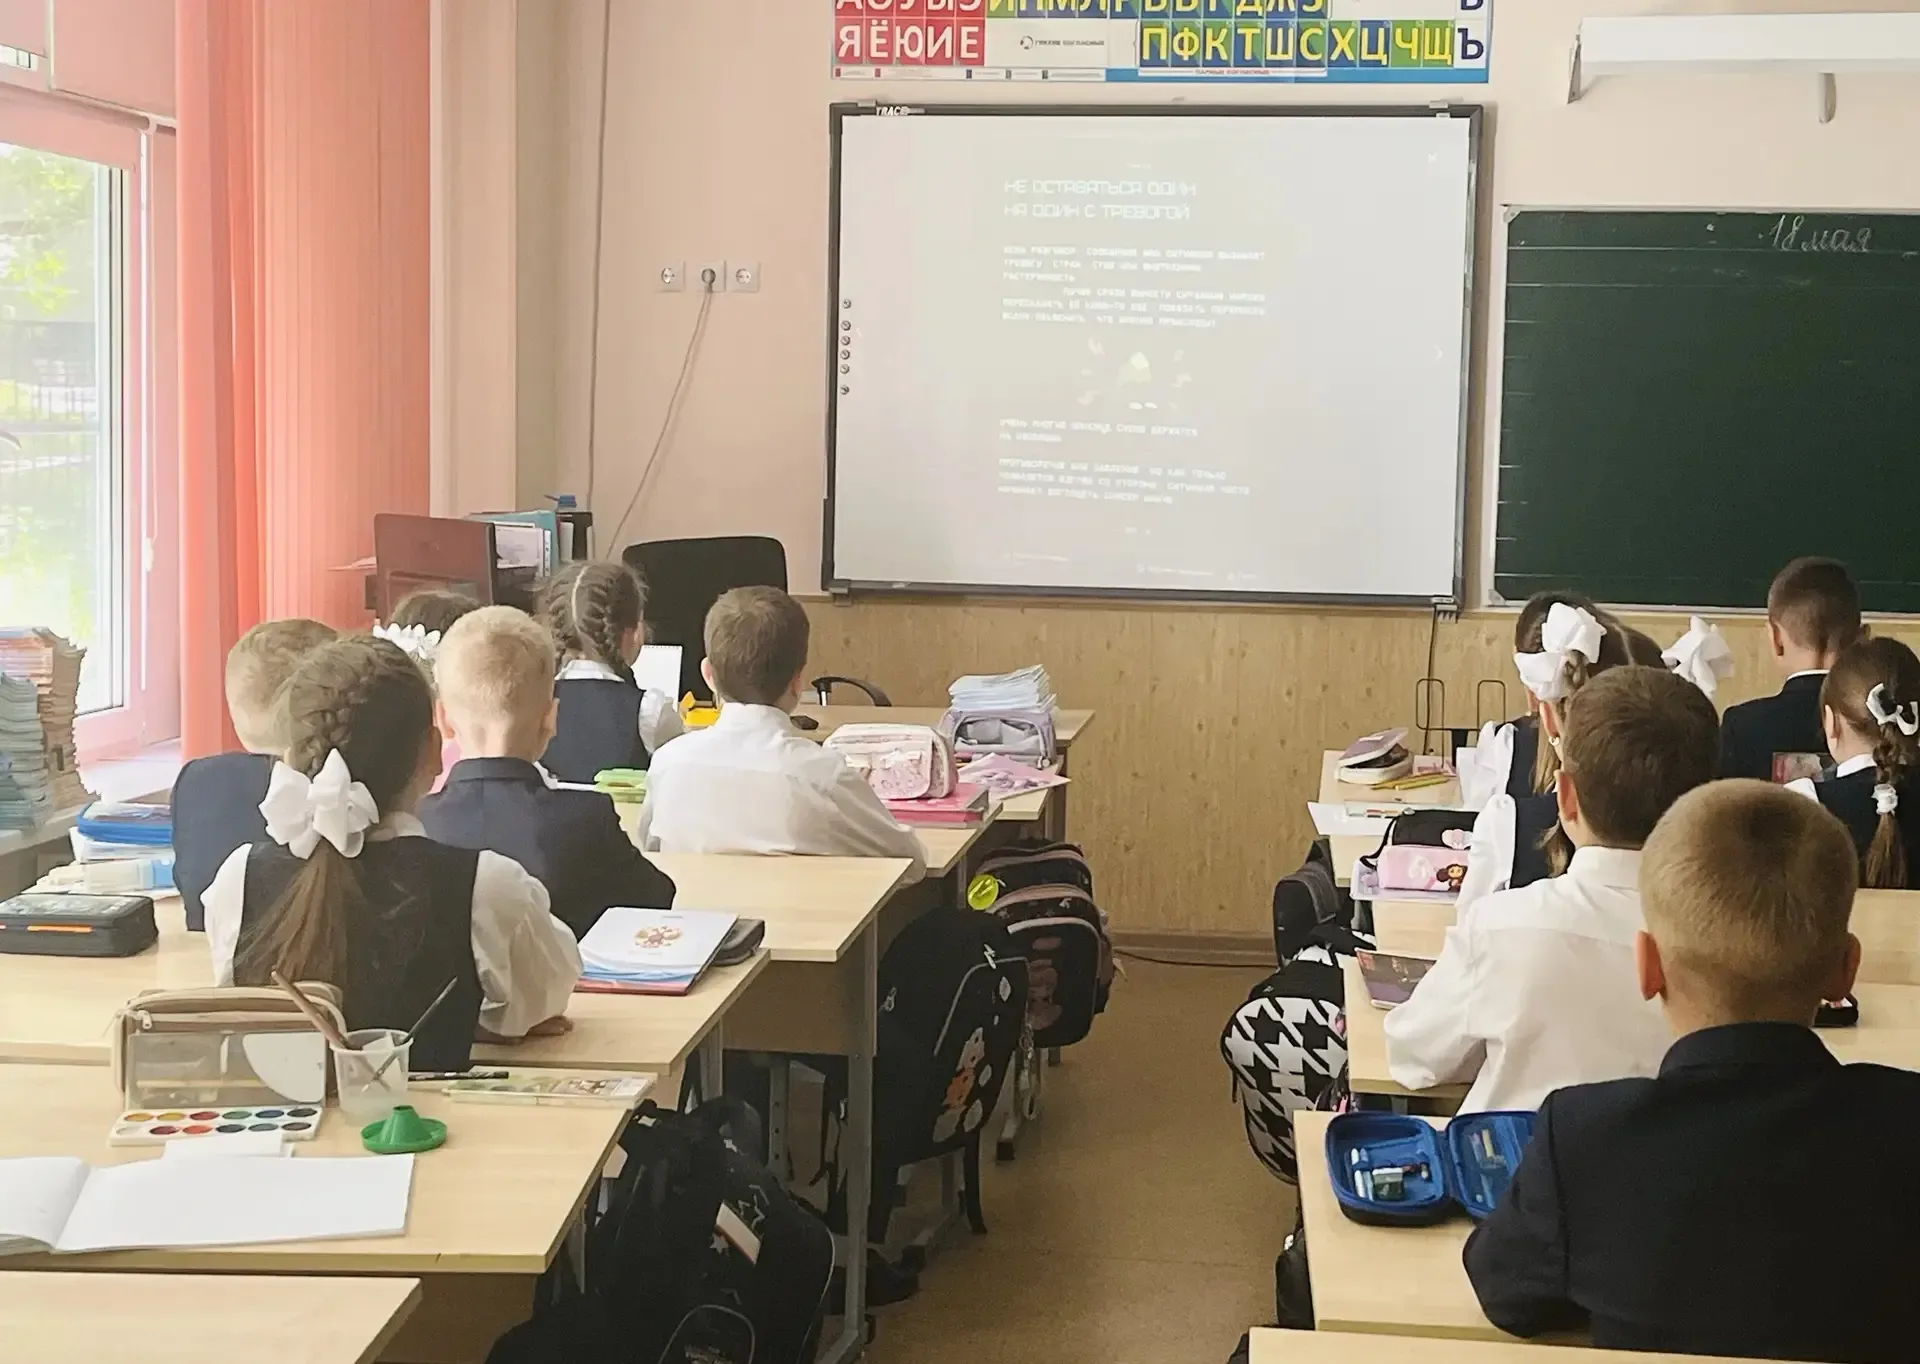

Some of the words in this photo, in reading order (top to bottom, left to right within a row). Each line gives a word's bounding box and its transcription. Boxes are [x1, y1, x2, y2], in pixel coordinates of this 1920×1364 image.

[1004, 180, 1027, 194] НЕ
[1032, 180, 1143, 195] ОСТАВАТЬСЯ
[1147, 181, 1197, 196] ОДИН
[1004, 203, 1028, 217] НА
[1032, 203, 1080, 218] ОДИН
[1100, 201, 1191, 220] ТРЕВОГОЙ
[1769, 214, 1804, 251] 18
[1801, 227, 1872, 252] мая
